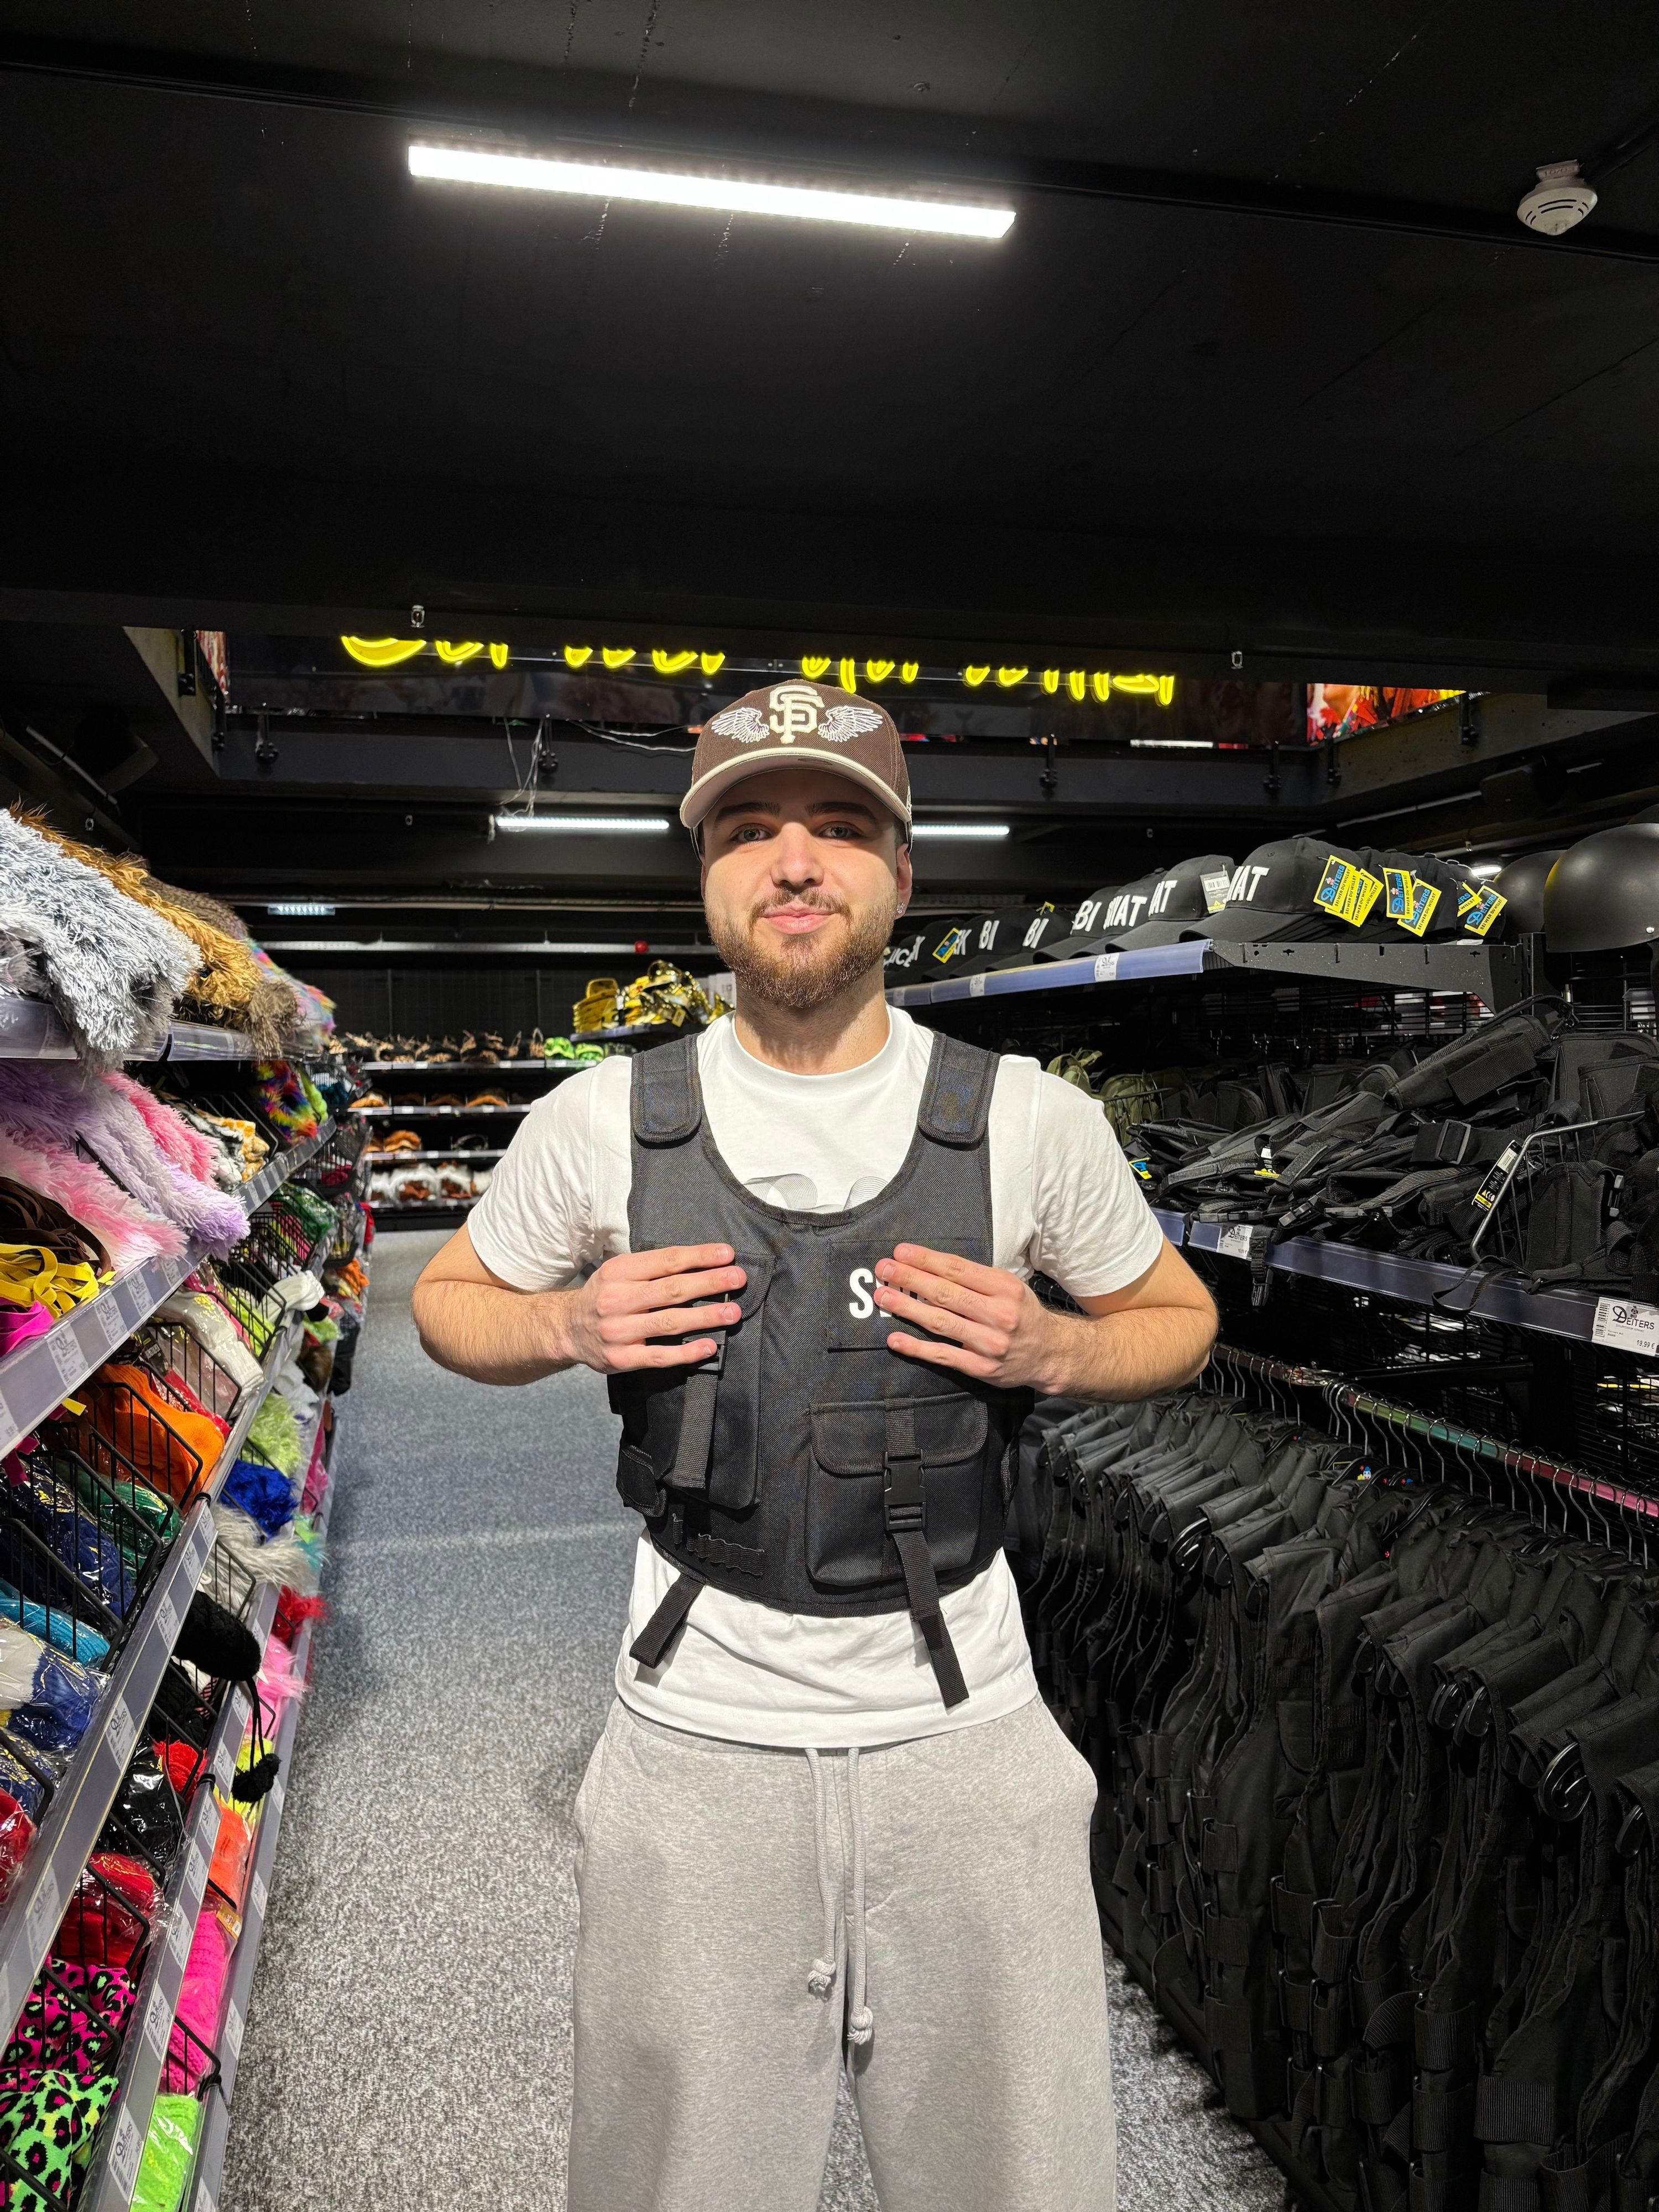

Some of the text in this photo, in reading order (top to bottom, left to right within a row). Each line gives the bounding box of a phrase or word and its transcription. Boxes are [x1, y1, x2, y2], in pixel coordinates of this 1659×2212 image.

[769, 685, 825, 744] SF
[1321, 864, 1346, 903] DEITERS
[1342, 868, 1351, 884] WILLST
[1391, 873, 1404, 913] DEITERS
[1427, 892, 1436, 907] WILLST
[1459, 898, 1475, 910] WILLST
[1071, 900, 1102, 934] BI
[1467, 894, 1497, 926] DEITERS
[1483, 913, 1492, 924] WER
[1493, 898, 1503, 910] WILLST
[979, 920, 1000, 950] BI
[1022, 918, 1049, 948] BI
[1612, 1306, 1655, 1329] DEITERS
